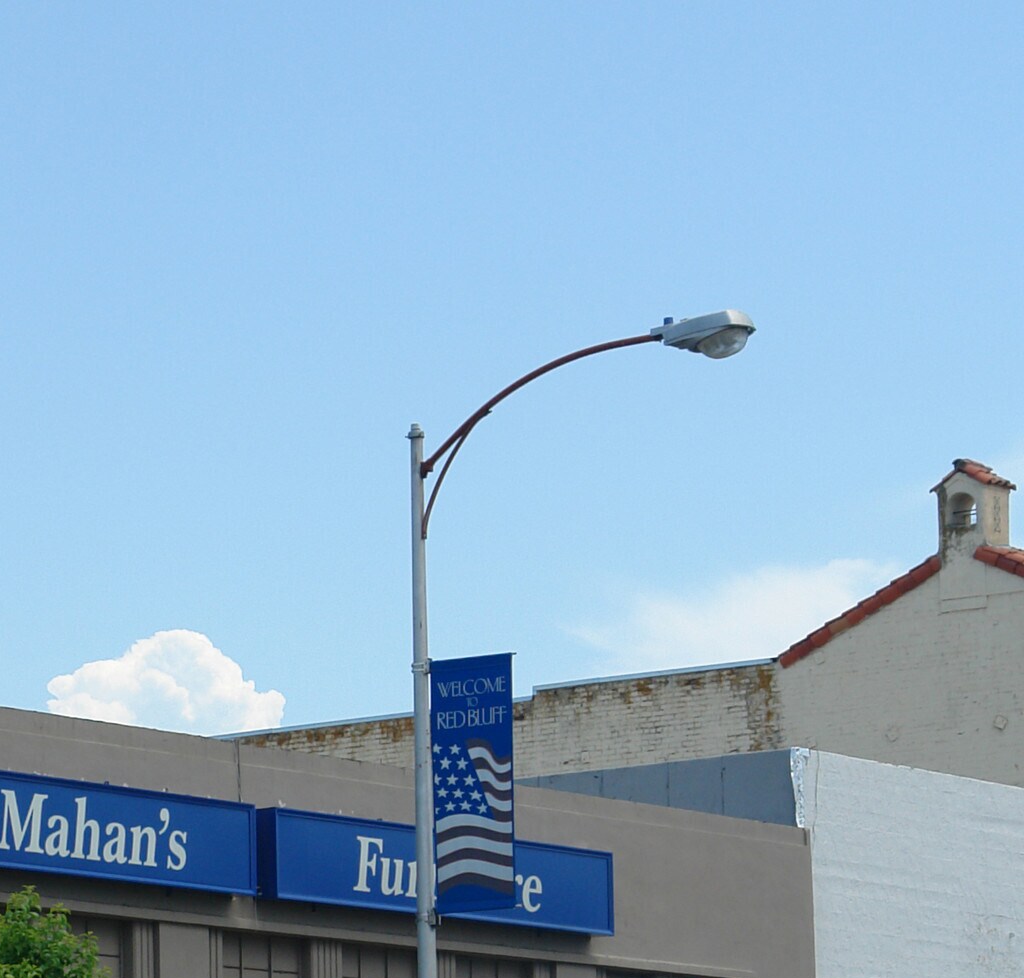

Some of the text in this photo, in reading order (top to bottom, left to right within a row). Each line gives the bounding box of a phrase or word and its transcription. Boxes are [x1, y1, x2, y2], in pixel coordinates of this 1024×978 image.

[437, 676, 506, 698] WELCOME
[466, 696, 479, 707] TO
[437, 705, 508, 731] RED BLUFF
